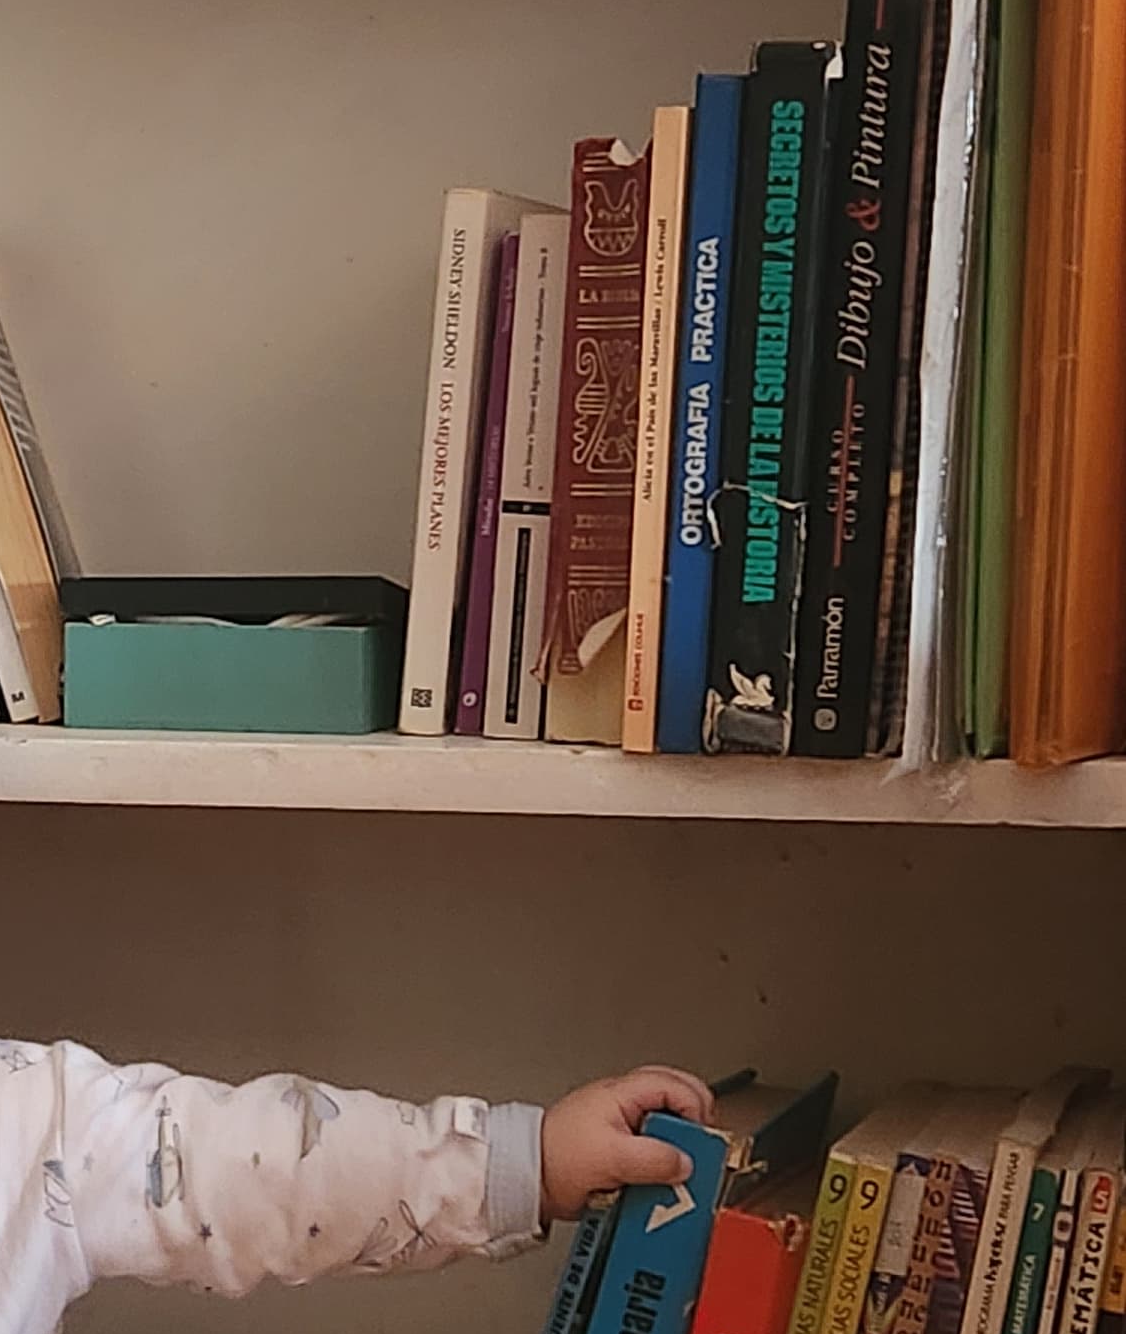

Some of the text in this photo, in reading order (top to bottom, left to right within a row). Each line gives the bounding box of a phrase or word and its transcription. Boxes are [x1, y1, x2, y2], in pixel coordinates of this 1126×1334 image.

[764, 100, 805, 234] SECRETOS
[836, 44, 891, 369] Dibujo & Pintura
[653, 218, 667, 297] Lewis Carroll
[762, 237, 796, 258] Y
[442, 228, 466, 369] SIDNEY SHELDON
[578, 289, 599, 304] LA
[753, 260, 794, 403] MISTERIOS
[642, 307, 662, 501] Alicia en el de las Maravillas
[680, 237, 719, 545] ORTOGRAFIA PRACTICA
[750, 406, 784, 440] DE
[428, 383, 454, 550] LOS MEJORES PLANES
[747, 442, 782, 476] LA
[827, 430, 844, 514] CURSO
[842, 404, 865, 541] COMPLETO
[816, 597, 844, 698] Parramón
[828, 1173, 847, 1205] 9
[859, 1179, 880, 1211] 9
[997, 1194, 1012, 1220] PARA
[1003, 1152, 1020, 1192] PENSAR
[1031, 1202, 1045, 1221] 7
[1093, 1189, 1110, 1211] 5
[566, 1262, 584, 1286] DE
[575, 1217, 600, 1257] VIDA
[801, 1218, 839, 1310] NATURALES
[837, 1224, 870, 1303] SOCIALES
